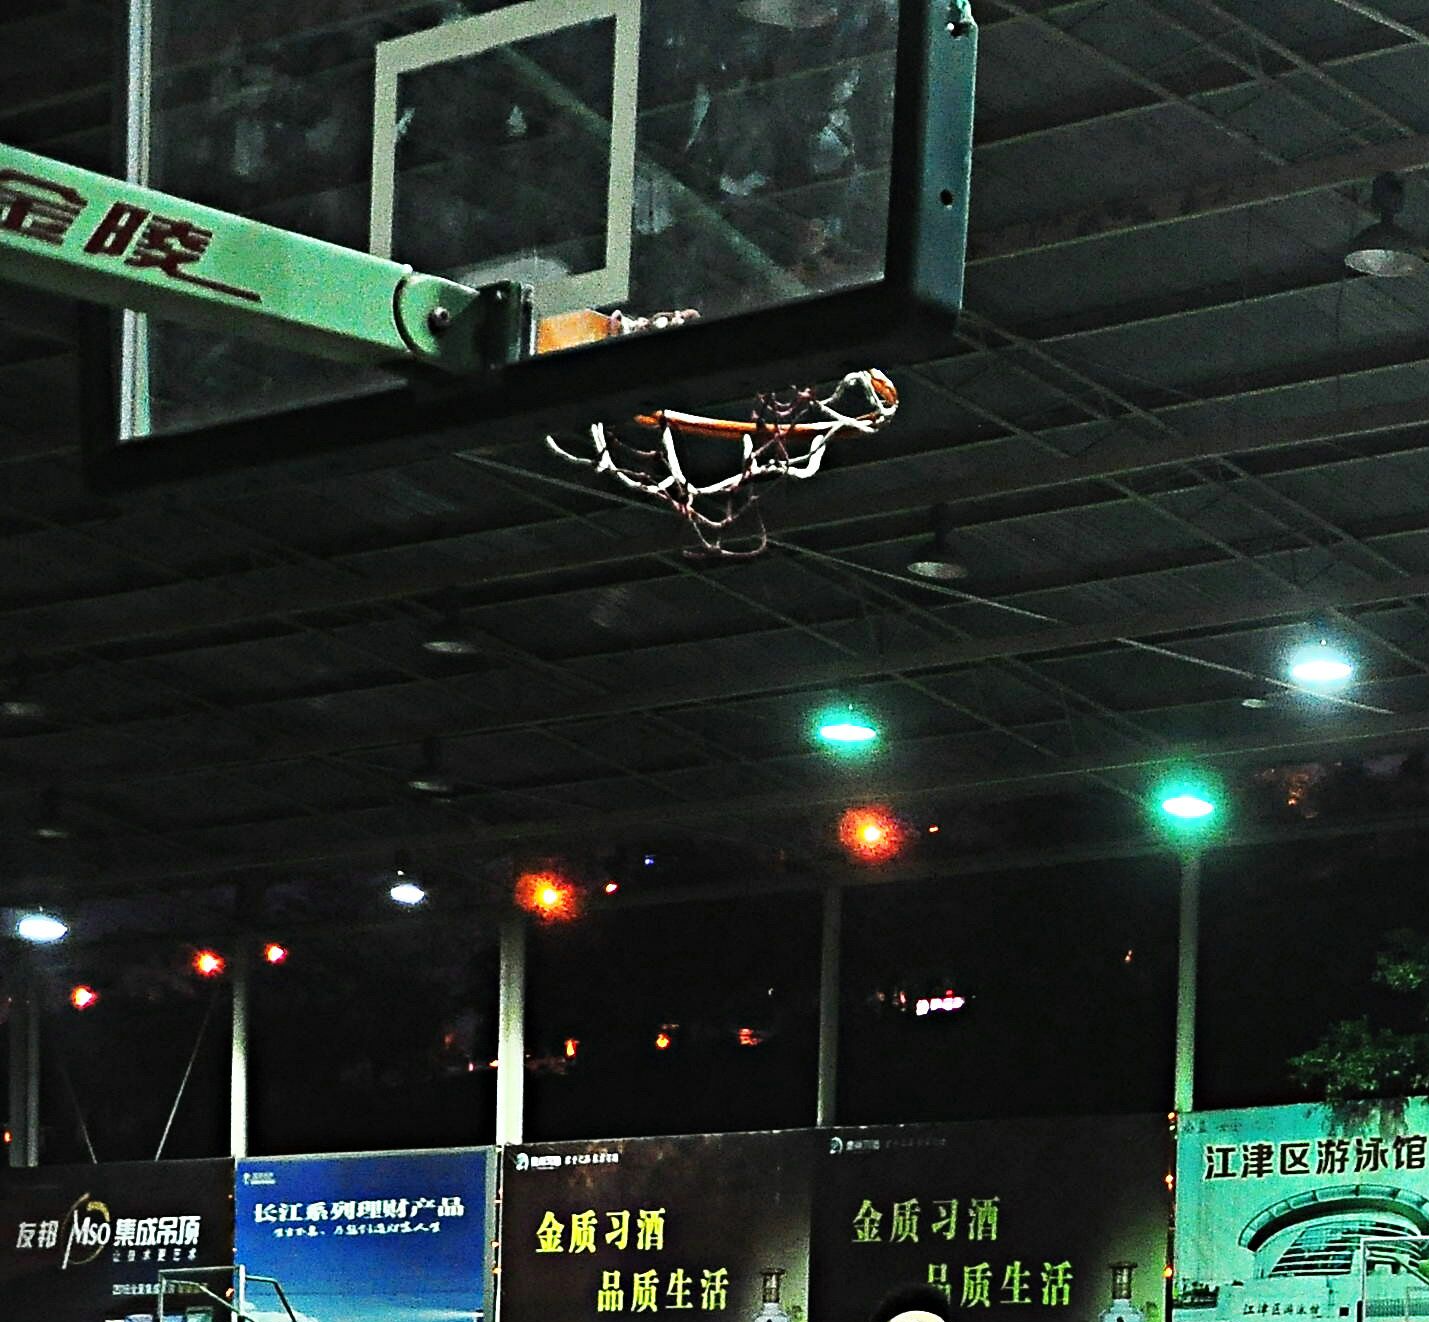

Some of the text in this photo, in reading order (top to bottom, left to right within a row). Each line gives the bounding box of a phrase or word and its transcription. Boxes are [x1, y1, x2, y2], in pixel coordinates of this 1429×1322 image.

[16, 1220, 59, 1249] 友邦
[113, 1215, 201, 1246] 集成吊顶
[254, 1196, 465, 1223] 长江系列理财产品
[535, 1207, 666, 1253] 金质习酒
[852, 1196, 1000, 1243] 金质习酒
[597, 1267, 730, 1313] 品质生活
[927, 1260, 1074, 1308] 品质生活
